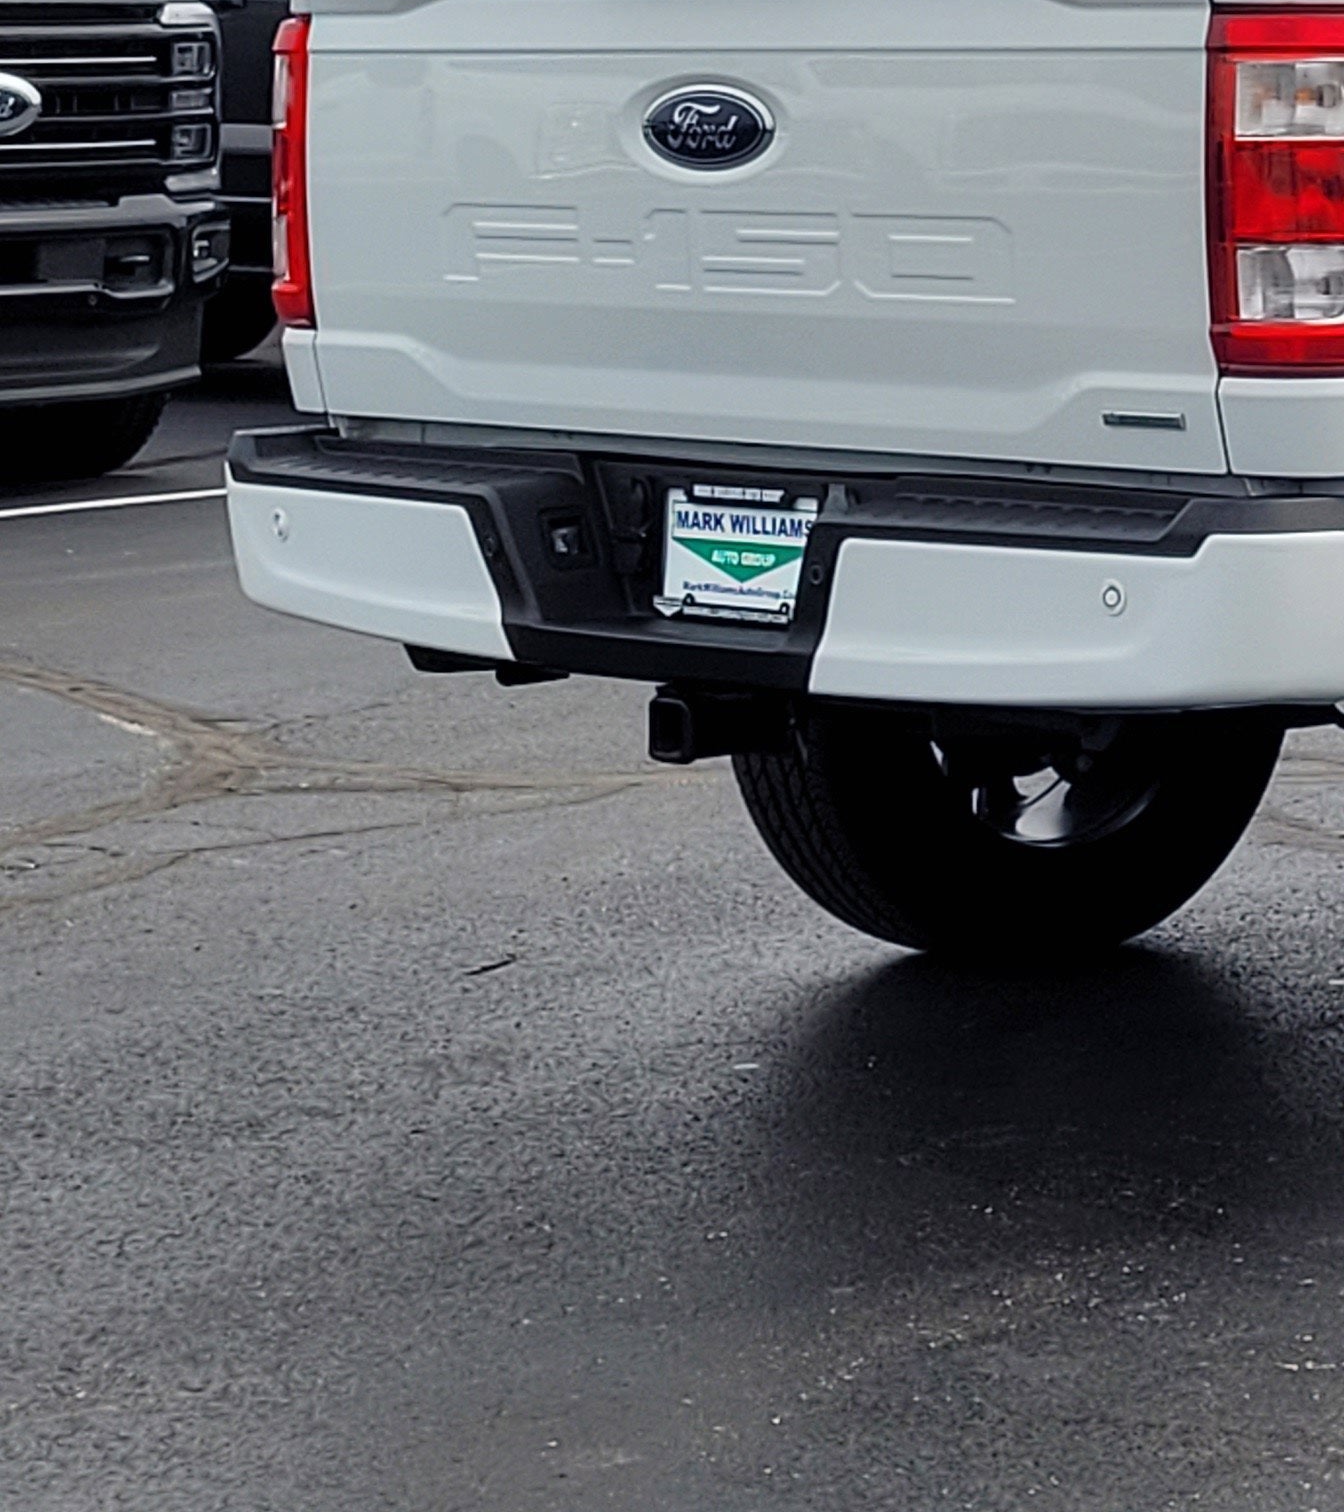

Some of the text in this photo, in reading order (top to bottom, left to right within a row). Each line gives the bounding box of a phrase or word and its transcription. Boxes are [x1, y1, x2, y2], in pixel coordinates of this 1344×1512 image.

[667, 102, 738, 149] Ford
[443, 202, 1016, 305] F-150
[676, 510, 813, 538] MARK WILLIAMS
[711, 549, 776, 567] AUTO GROUP
